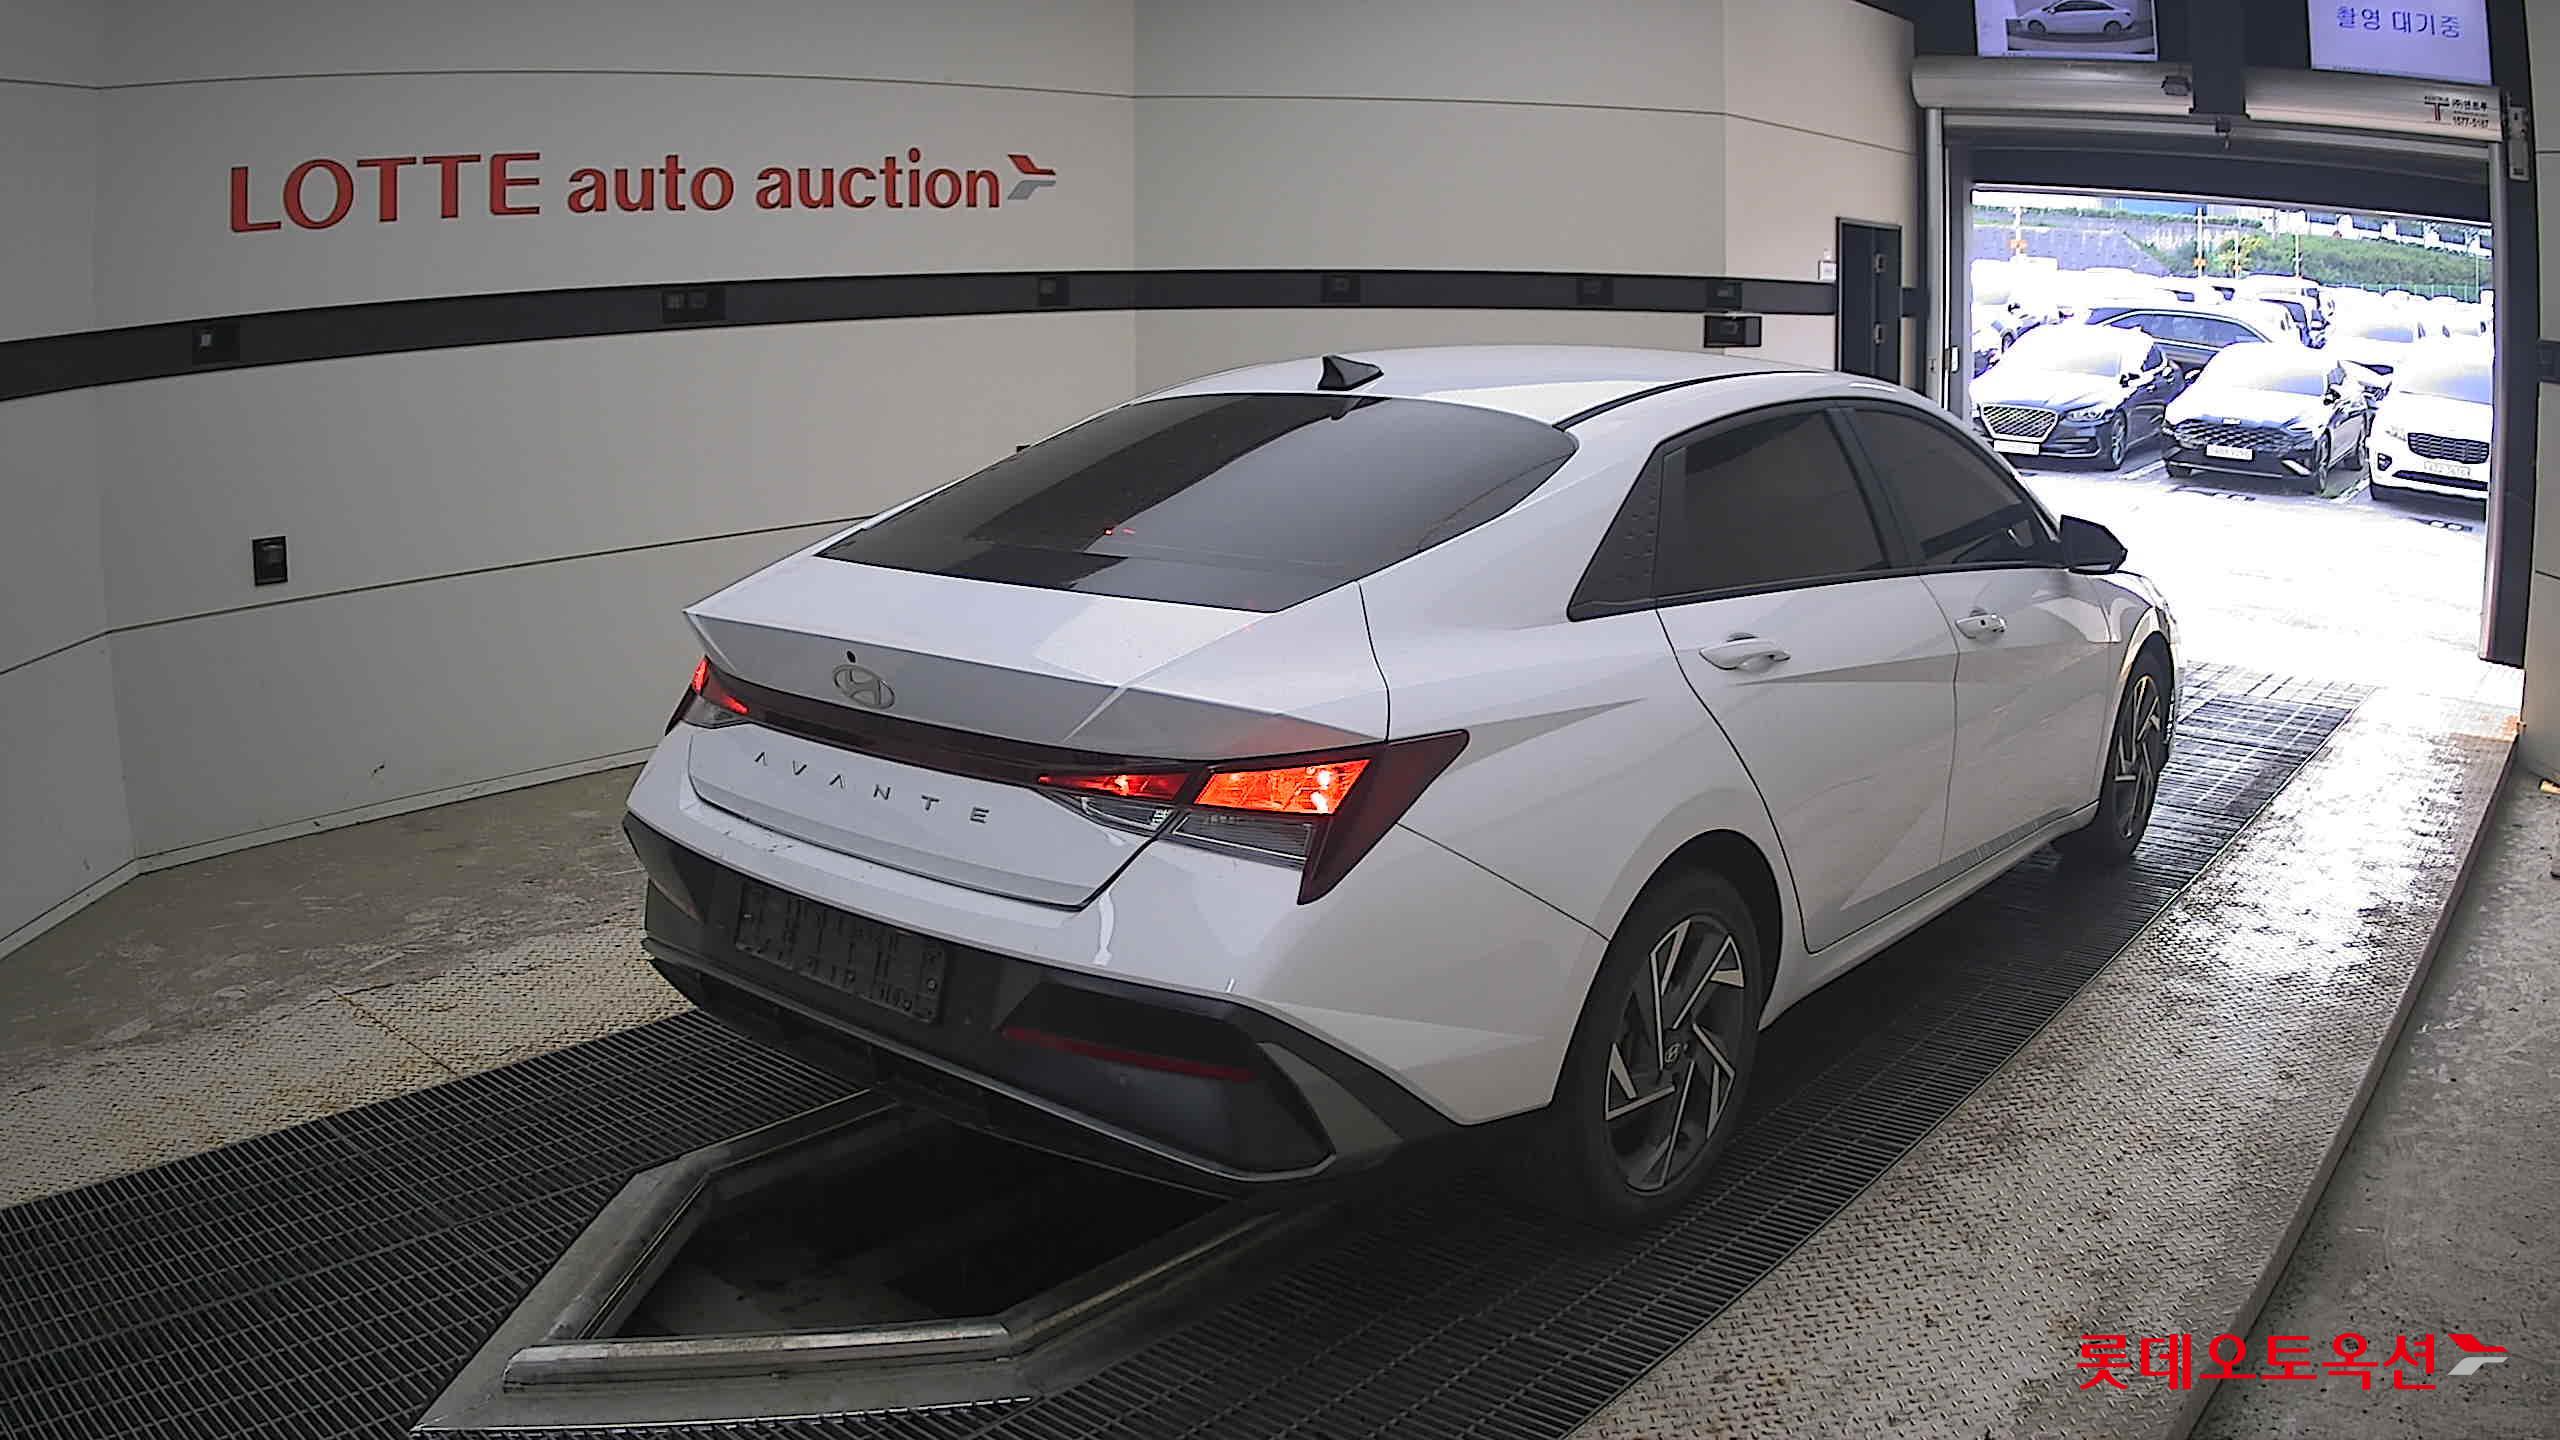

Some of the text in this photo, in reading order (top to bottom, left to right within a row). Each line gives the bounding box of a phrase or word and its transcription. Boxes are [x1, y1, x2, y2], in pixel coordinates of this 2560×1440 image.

[2391, 11, 2460, 39] 대기중
[230, 146, 1001, 233] LOTTE auto auction
[754, 751, 990, 825] AVANTE
